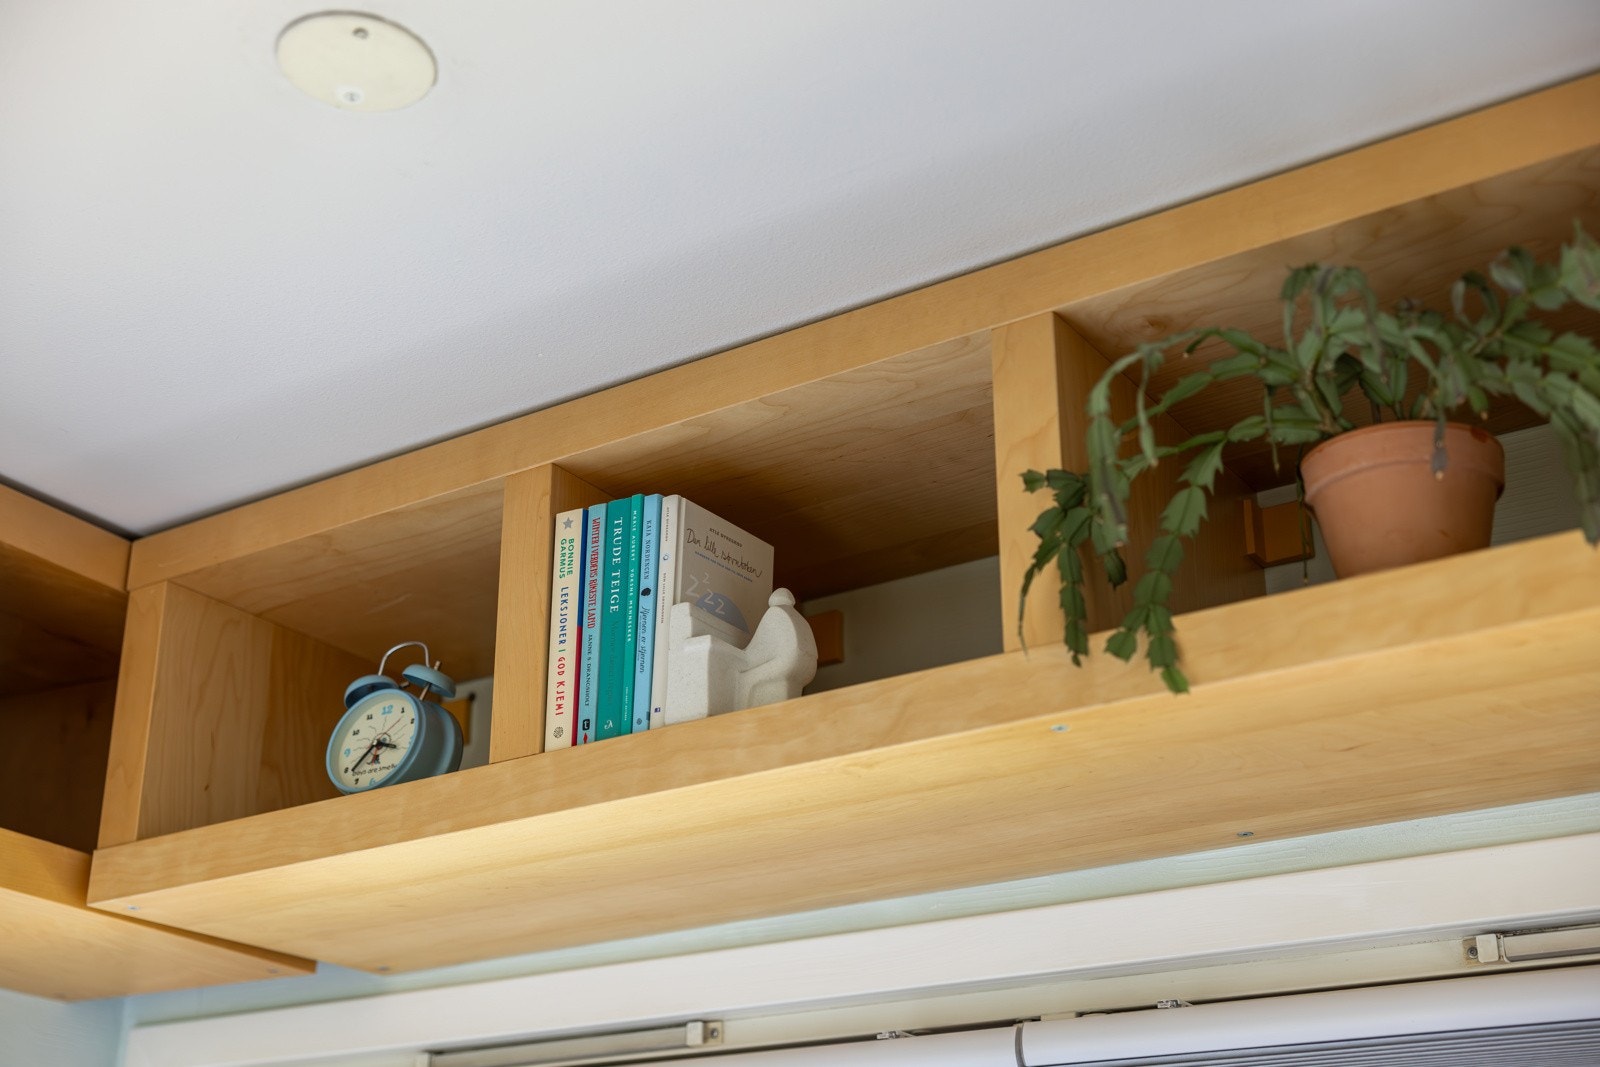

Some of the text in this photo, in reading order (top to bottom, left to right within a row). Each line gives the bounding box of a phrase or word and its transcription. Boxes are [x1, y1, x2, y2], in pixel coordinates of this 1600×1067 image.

[591, 517, 600, 544] WINTER
[687, 528, 701, 547] Den
[559, 538, 567, 579] GARMUS
[566, 538, 574, 576] BONNIE
[589, 549, 598, 578] VERDENS
[610, 517, 623, 613] TRUDE TEIGE
[588, 579, 597, 608] RIKESTE
[558, 586, 569, 645] LEKSJONER
[587, 608, 596, 629] LAND
[640, 606, 650, 634] Hjernen
[557, 656, 566, 676] GOD
[638, 646, 647, 673] stjernen
[381, 704, 394, 715] 12
[555, 681, 566, 716] KJEMI
[344, 746, 351, 758] 9
[368, 778, 376, 786] 6
